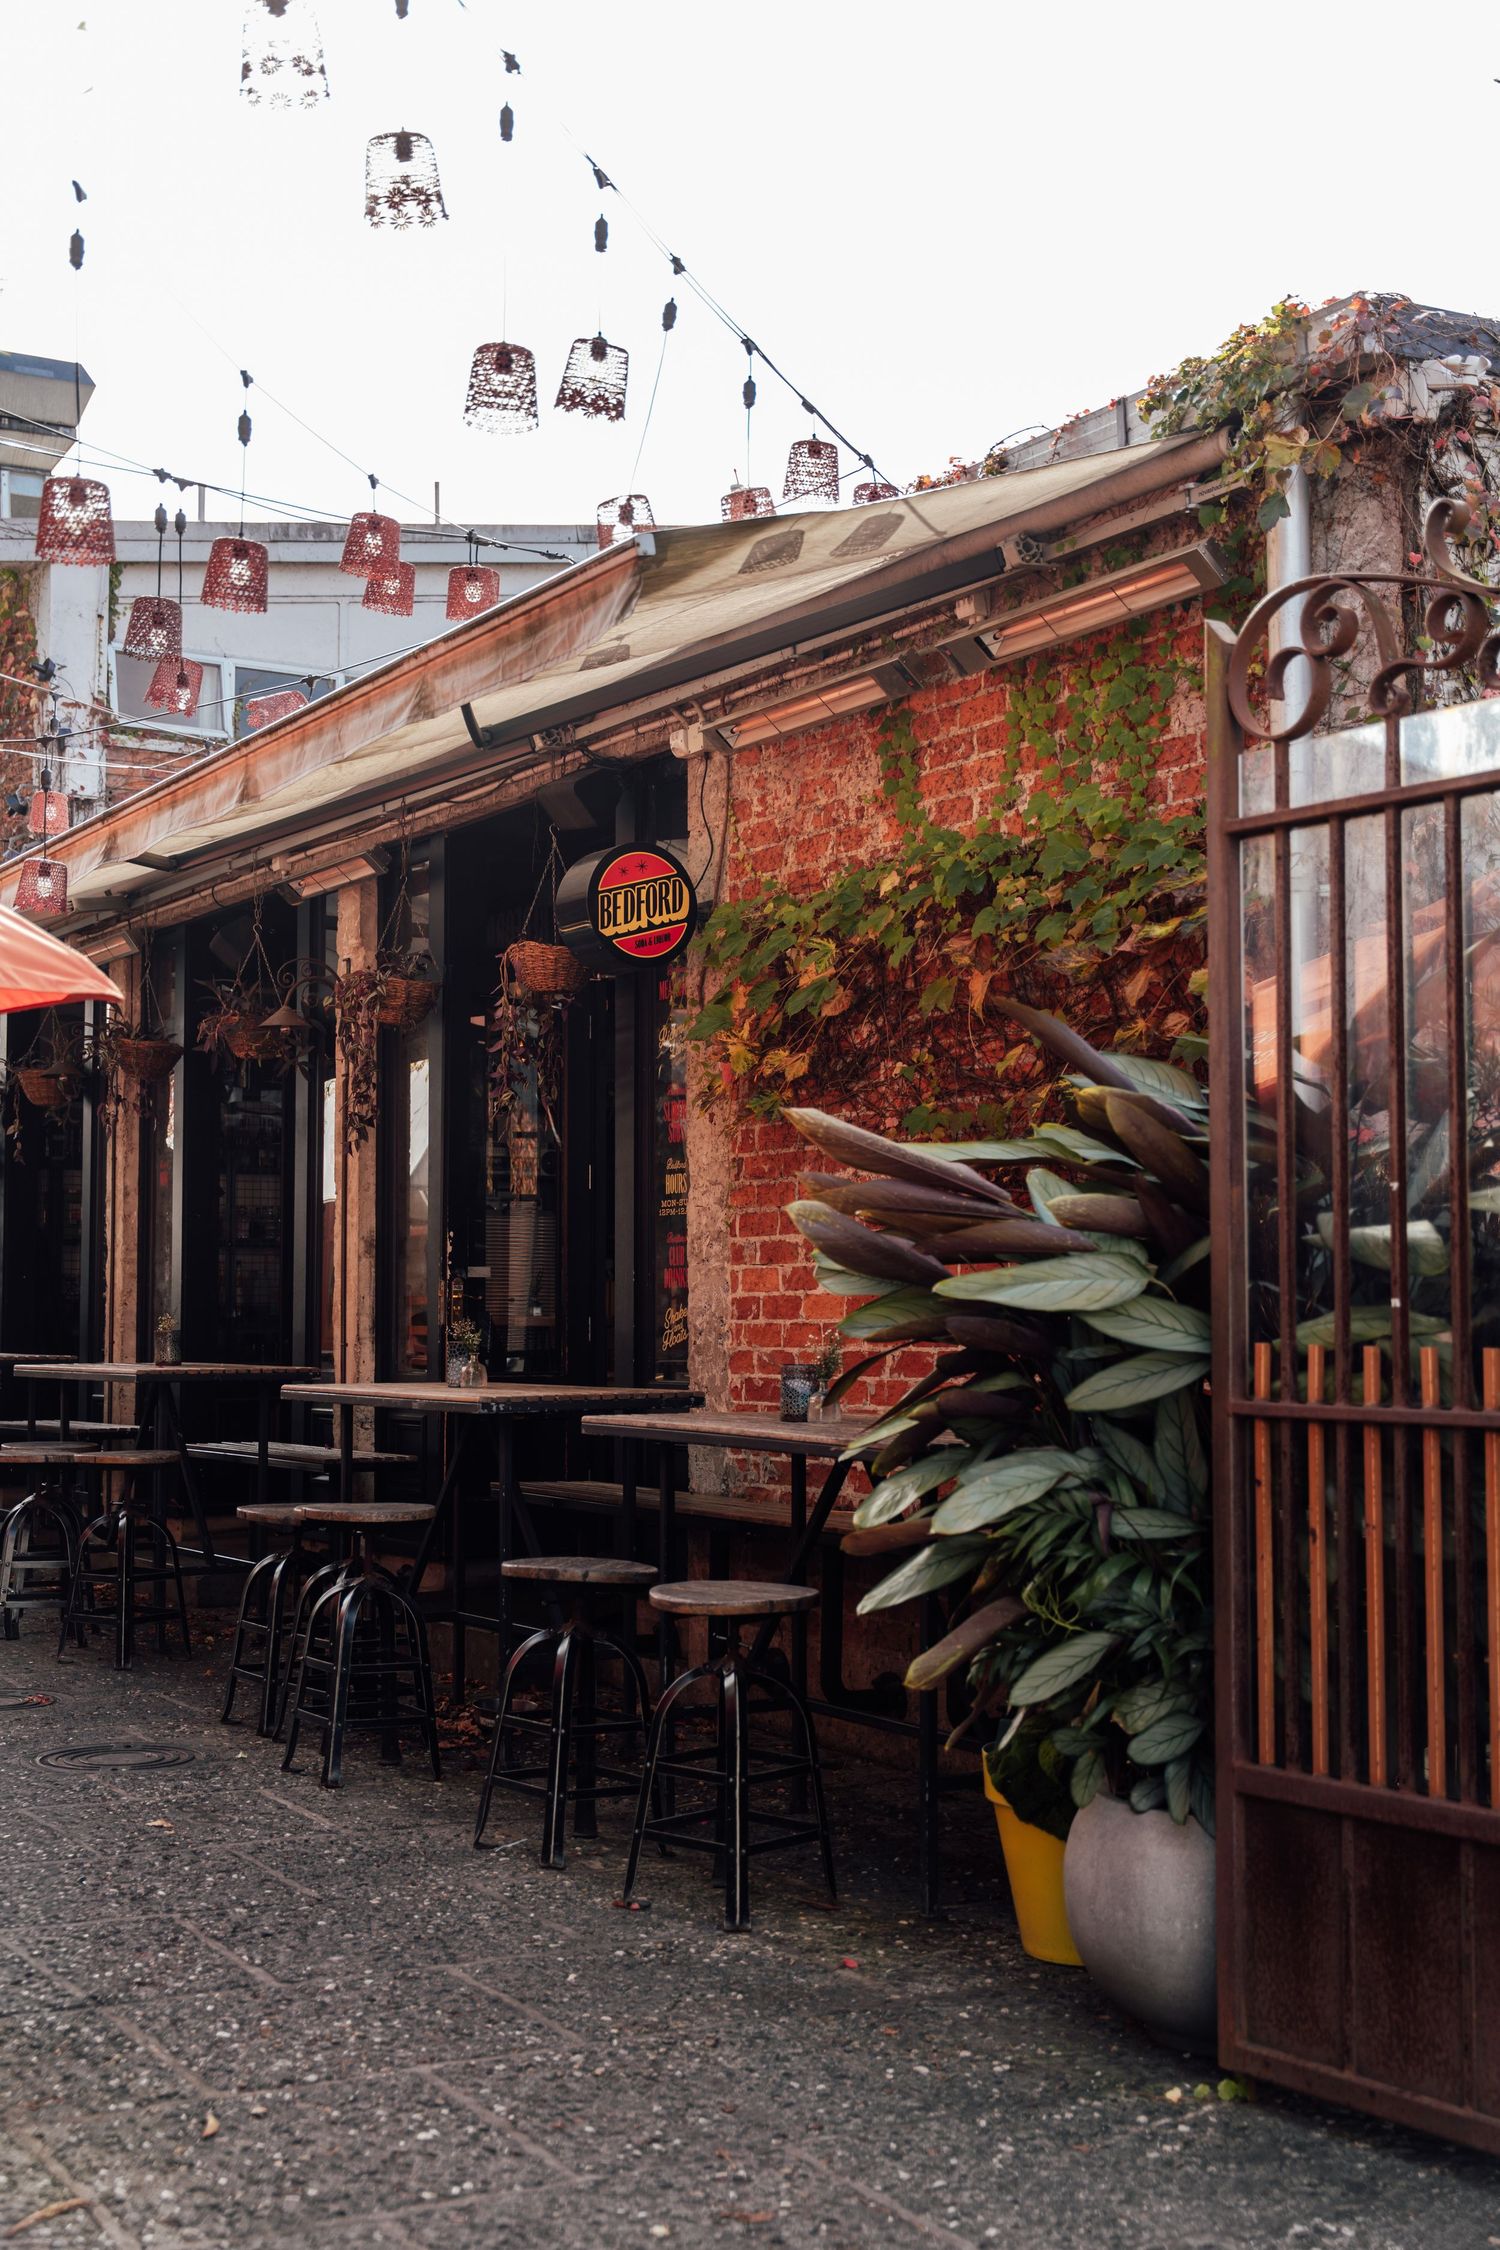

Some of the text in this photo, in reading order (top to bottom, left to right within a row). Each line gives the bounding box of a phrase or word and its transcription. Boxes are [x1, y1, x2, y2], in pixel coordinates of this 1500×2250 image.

[599, 877, 689, 936] BEDFORD
[665, 1172, 688, 1195] HOURS
[661, 1198, 688, 1208] MON-SU
